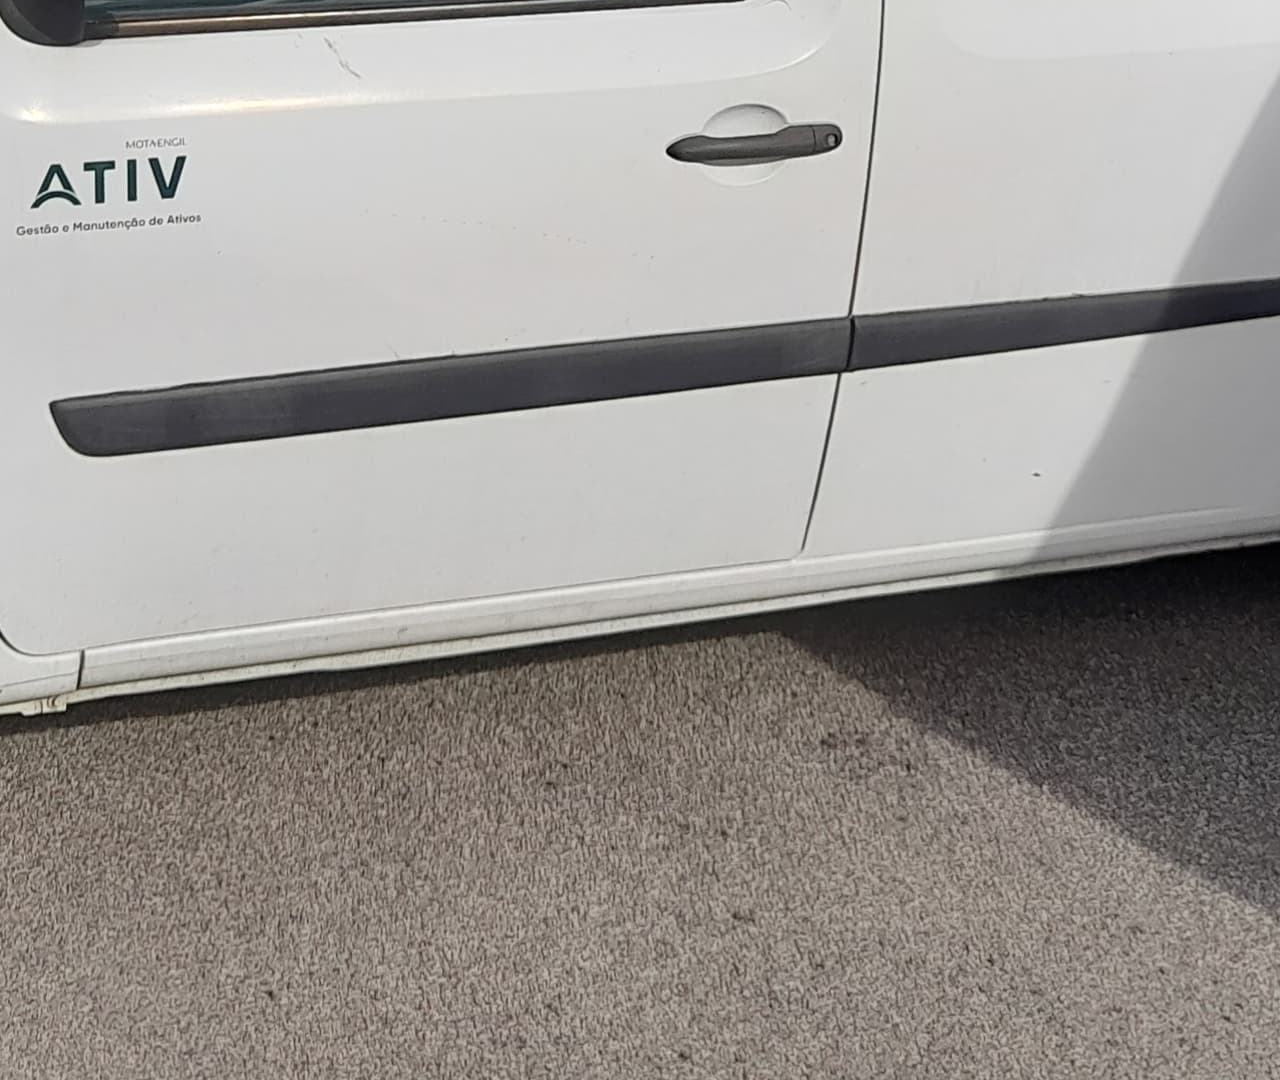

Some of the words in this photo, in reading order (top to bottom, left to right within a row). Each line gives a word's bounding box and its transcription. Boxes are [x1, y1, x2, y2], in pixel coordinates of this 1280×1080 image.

[30, 155, 187, 209] ATIV
[16, 223, 59, 236] Gestão
[62, 225, 70, 233] e
[73, 217, 146, 231] Manutenção
[148, 216, 164, 226] de
[167, 214, 202, 224] Ativos
